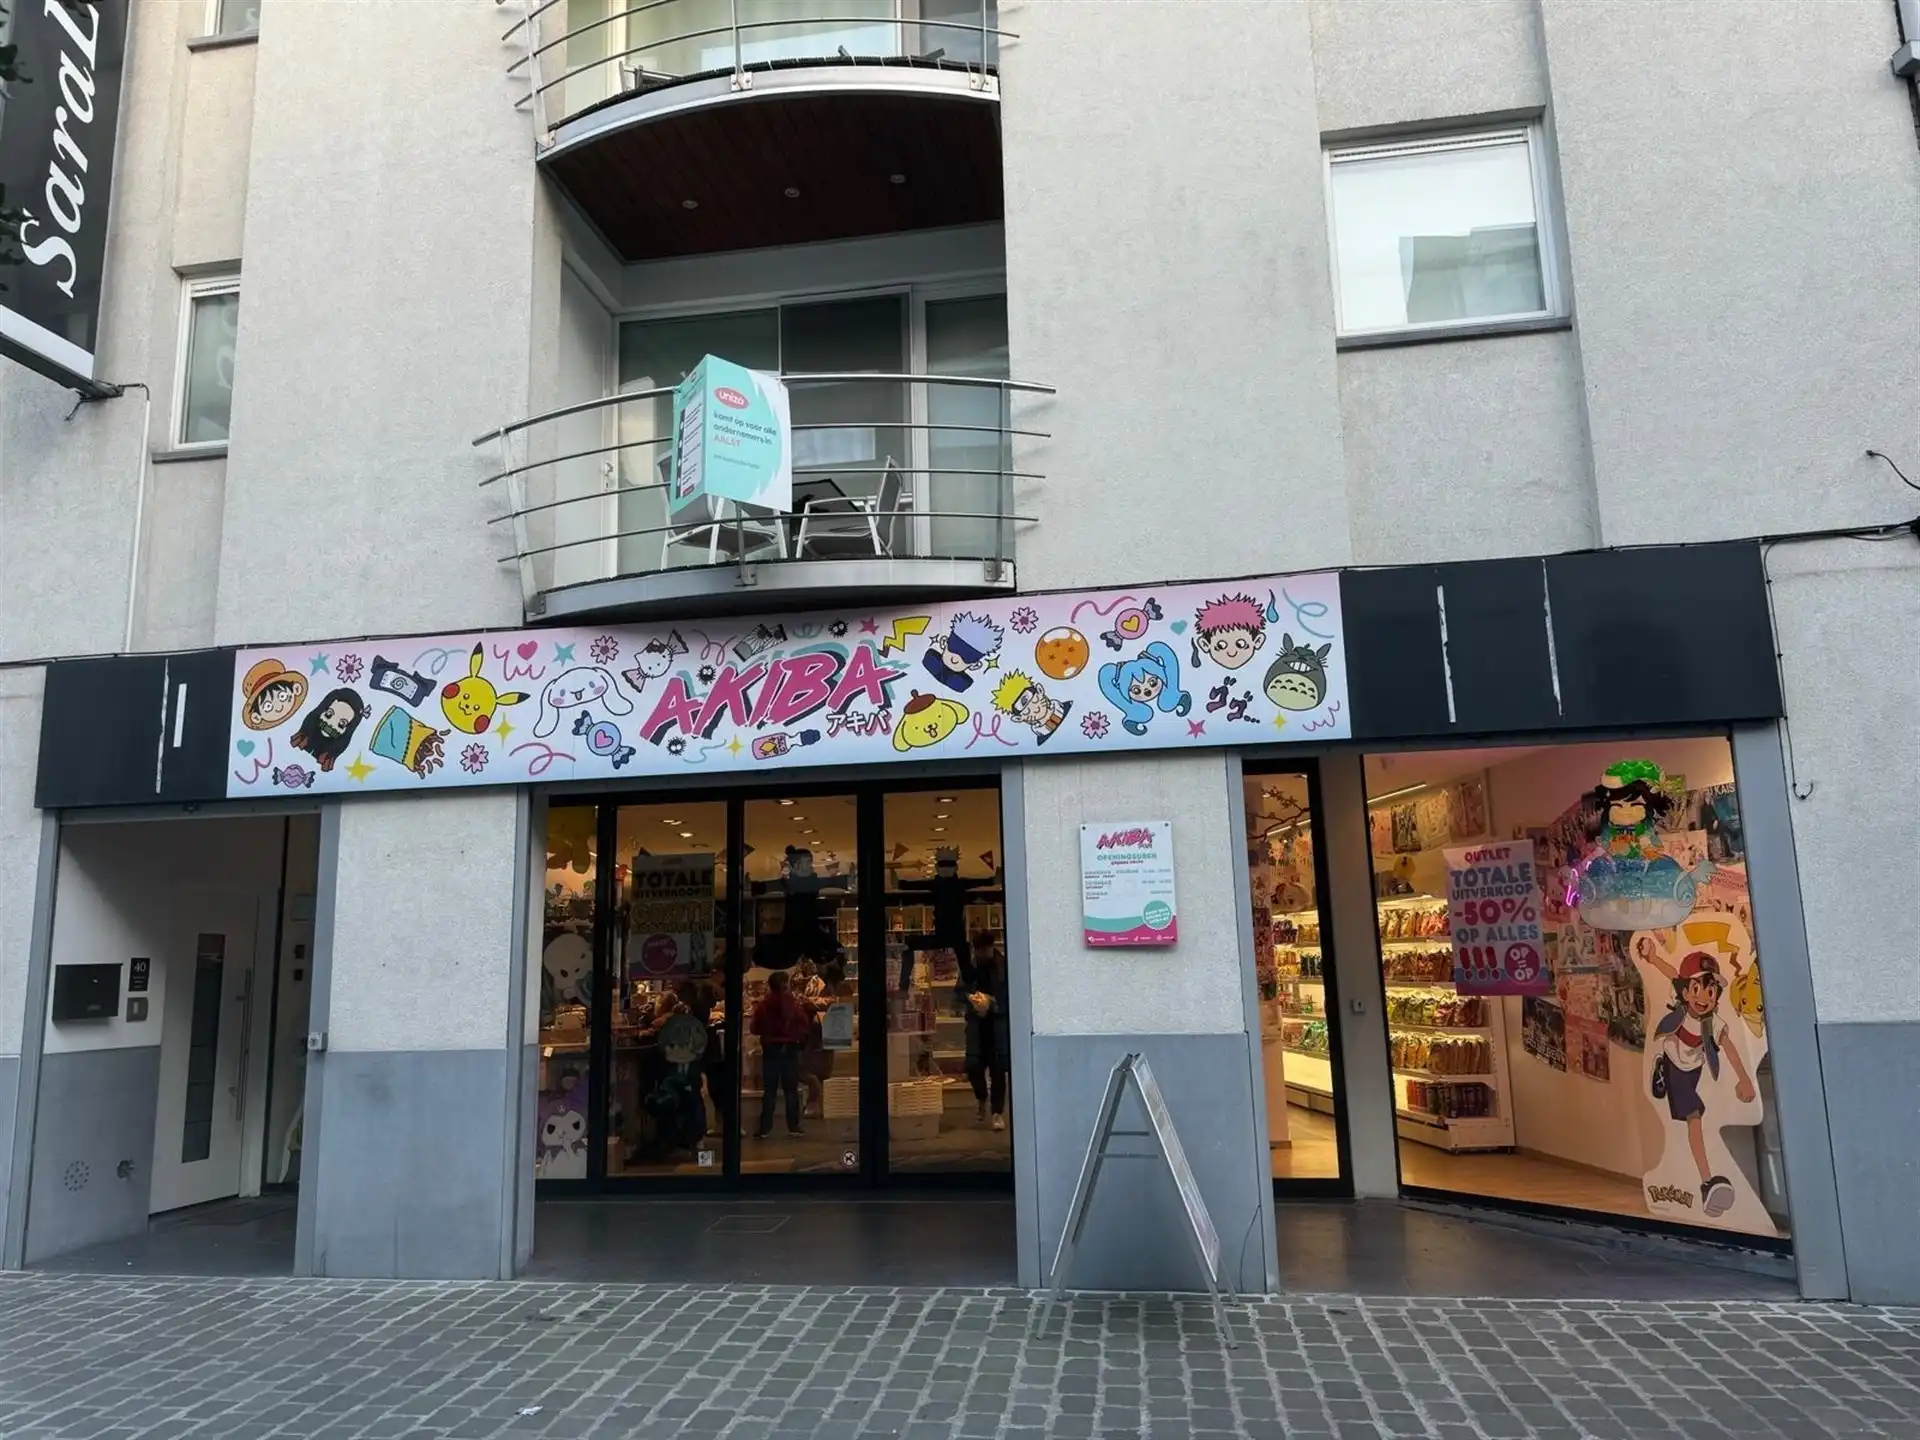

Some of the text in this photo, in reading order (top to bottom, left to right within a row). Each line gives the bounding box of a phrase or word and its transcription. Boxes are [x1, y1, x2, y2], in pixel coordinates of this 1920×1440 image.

[719, 391, 745, 405] unizo
[639, 641, 907, 746] AKIBA
[826, 709, 892, 737] アキバ
[1096, 828, 1155, 849] AKIBA
[1464, 847, 1510, 863] OUTLET
[634, 869, 713, 888] TOTALE
[1450, 862, 1532, 888] TOTALE
[1452, 883, 1534, 900] UITVERKOOP
[1454, 897, 1536, 926] -50%
[1456, 924, 1539, 944] OP ALLES
[1510, 946, 1530, 961] OP
[1514, 968, 1534, 982] OP
